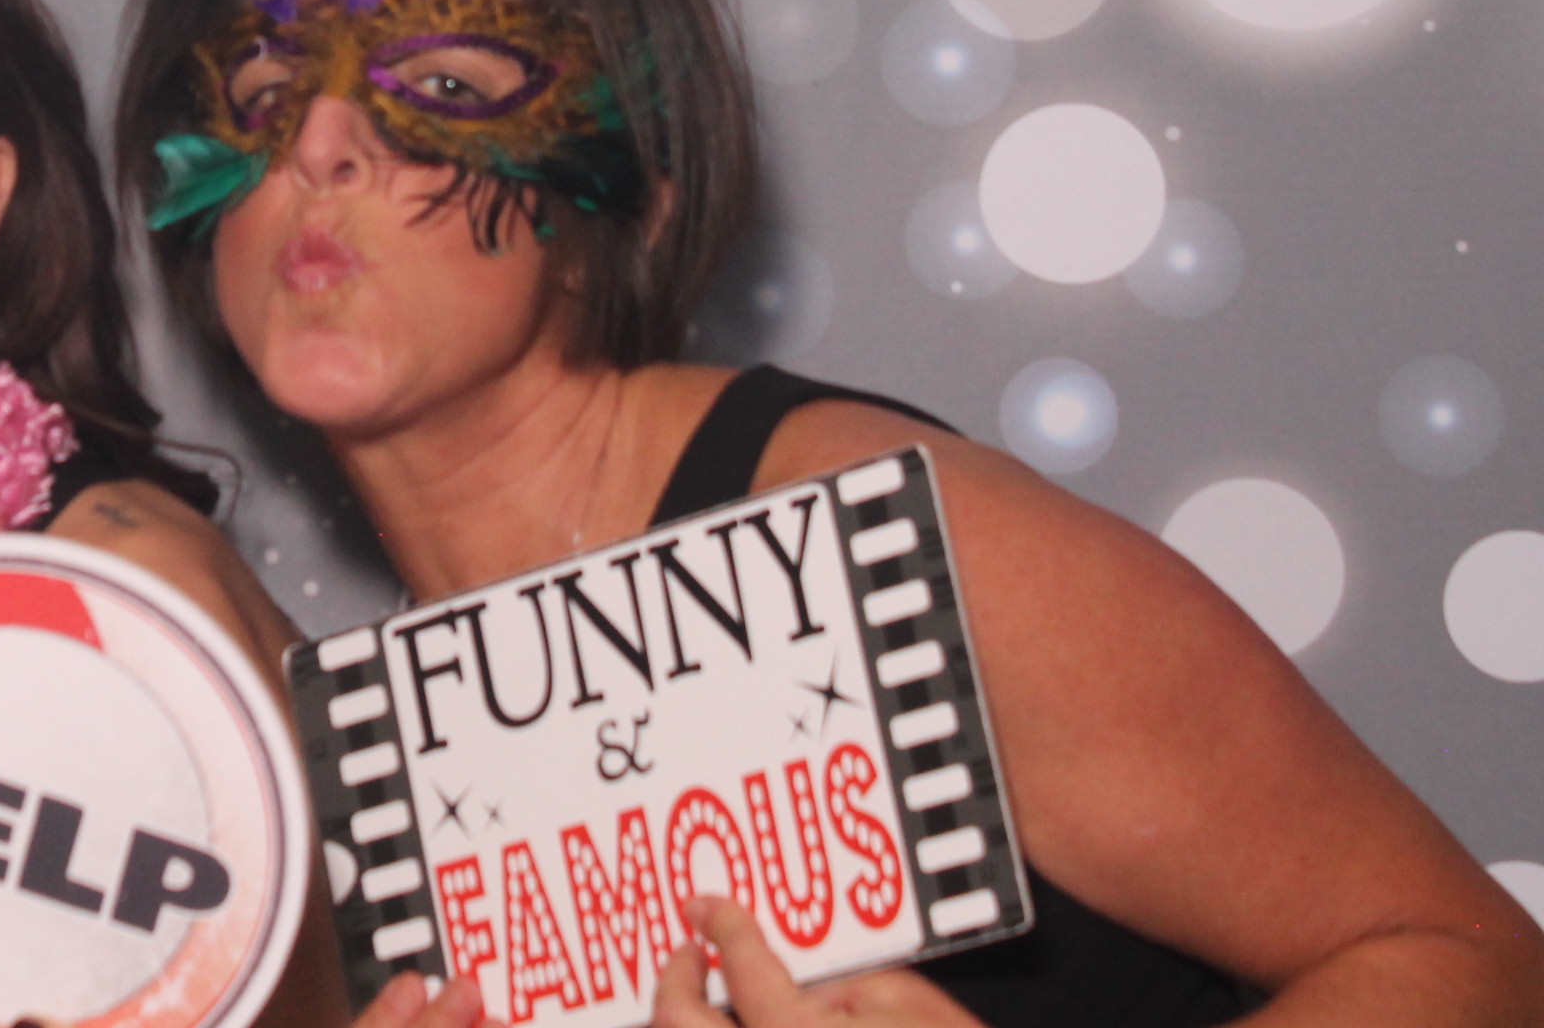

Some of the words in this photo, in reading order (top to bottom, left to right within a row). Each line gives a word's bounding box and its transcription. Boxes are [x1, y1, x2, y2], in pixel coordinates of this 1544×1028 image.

[393, 494, 824, 755] FUNNY
[594, 710, 653, 782] &
[435, 742, 904, 1025] FAMOUS
